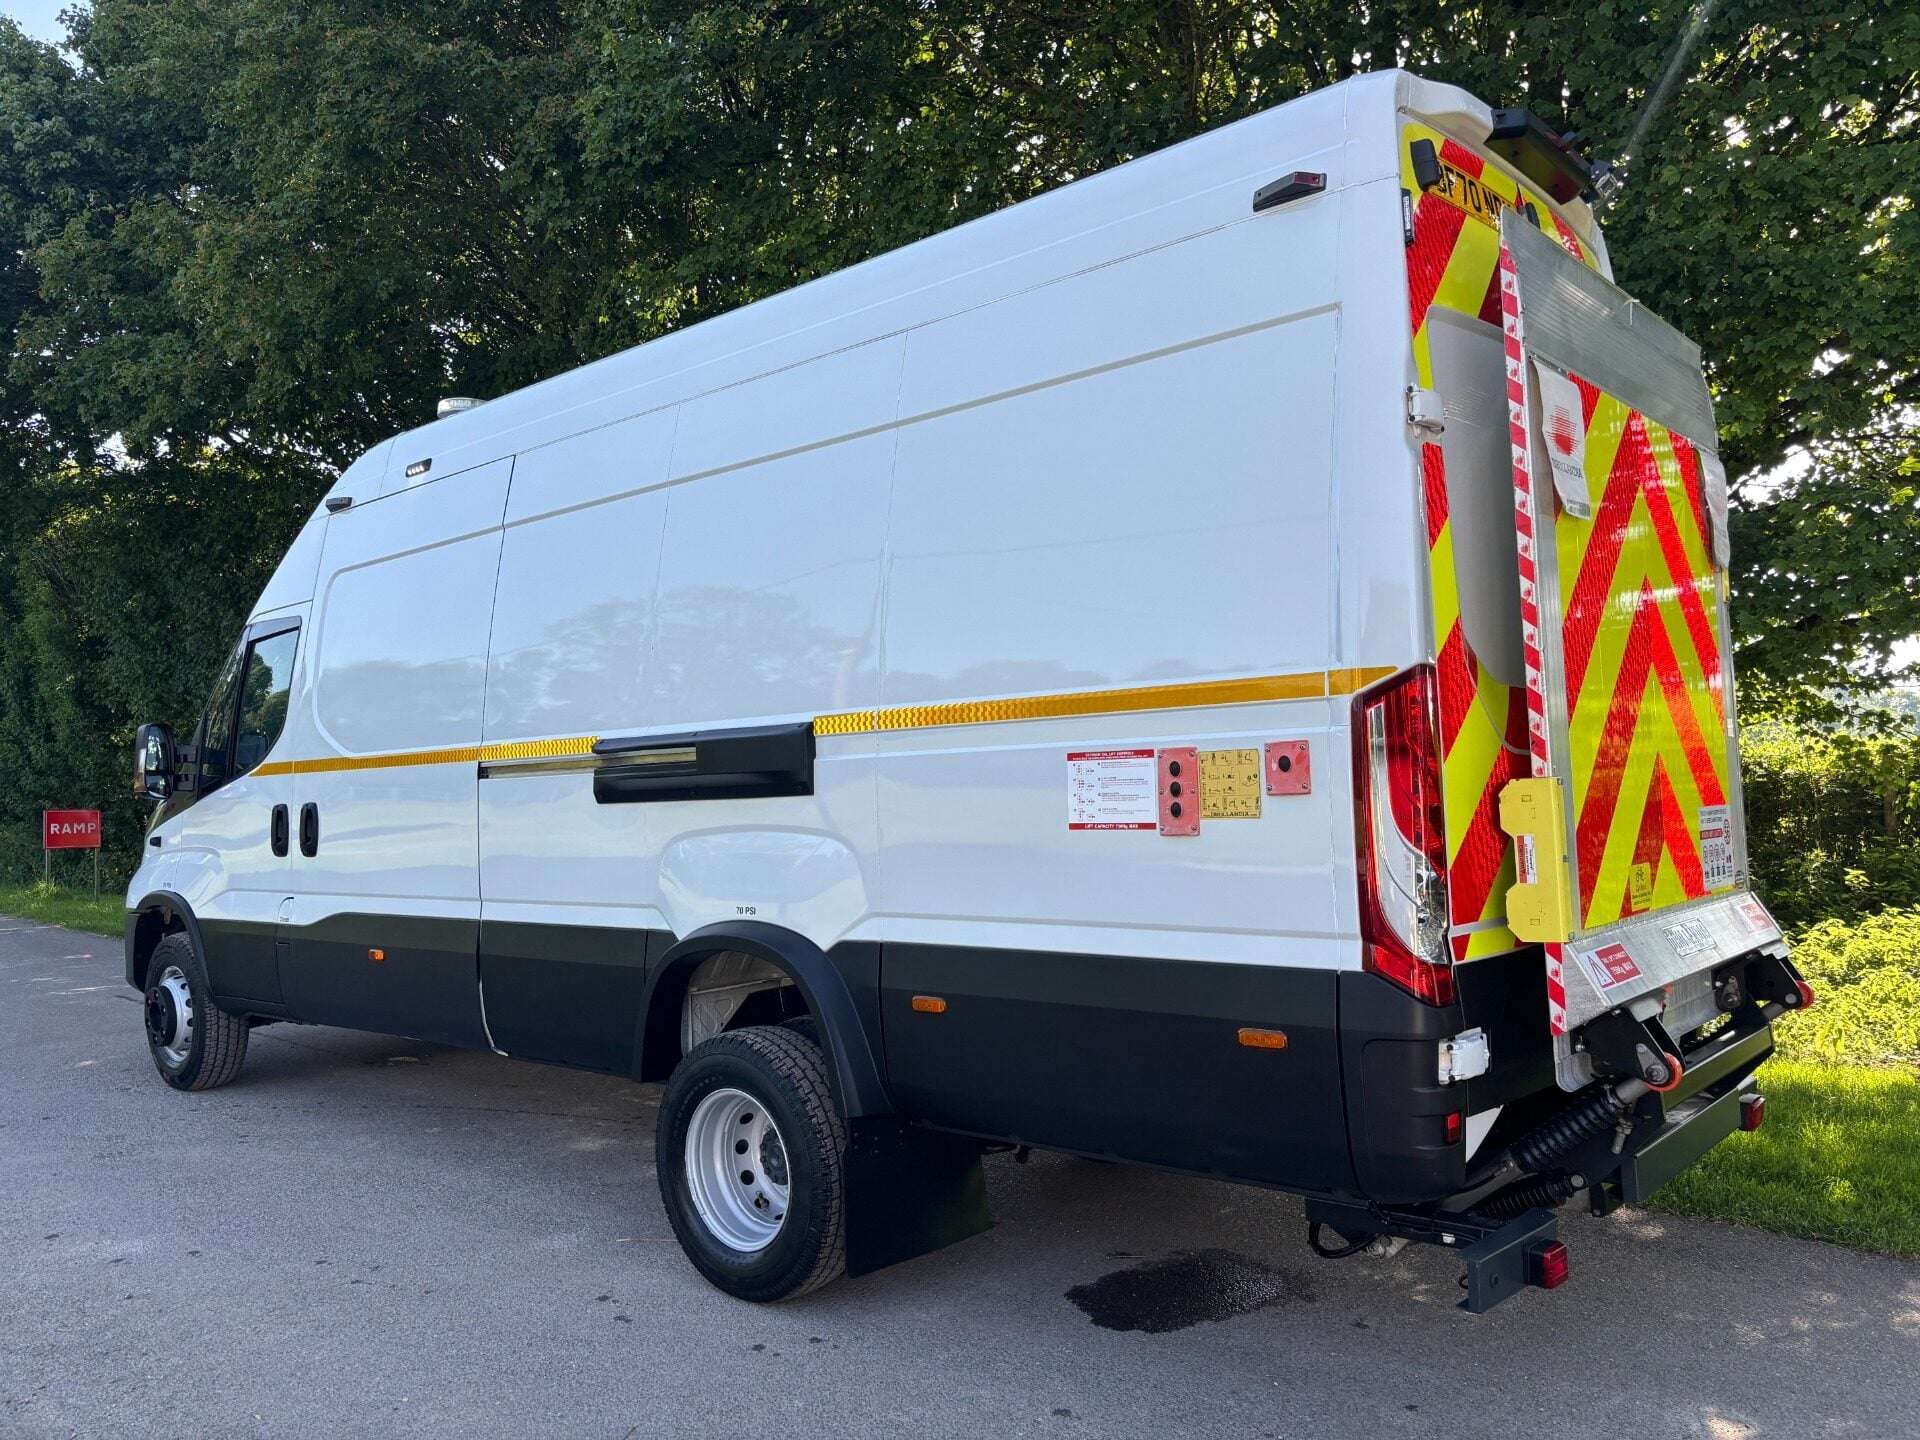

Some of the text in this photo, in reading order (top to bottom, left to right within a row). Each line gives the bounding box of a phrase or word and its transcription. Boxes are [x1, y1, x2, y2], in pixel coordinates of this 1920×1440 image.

[50, 822, 96, 835] RAMP
[736, 906, 756, 915] 70 PSI
